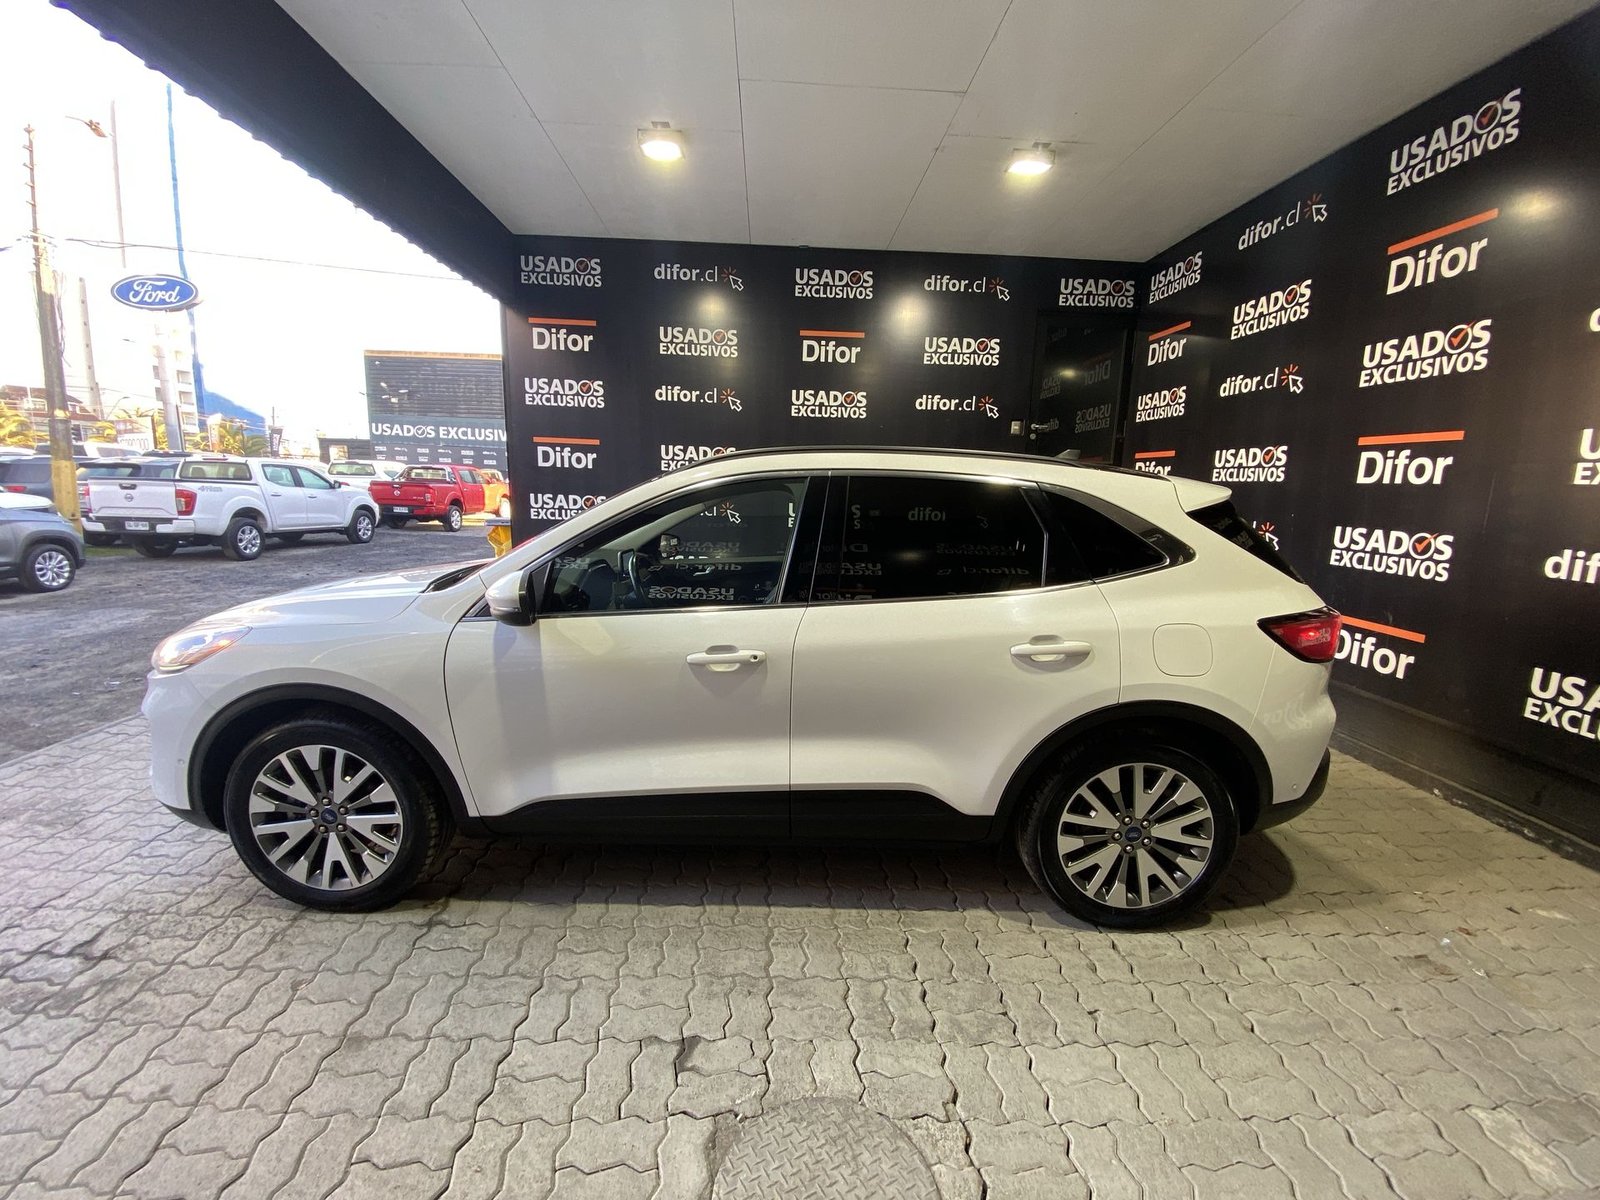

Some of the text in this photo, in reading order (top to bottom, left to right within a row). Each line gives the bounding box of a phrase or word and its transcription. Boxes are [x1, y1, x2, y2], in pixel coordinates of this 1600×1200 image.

[1390, 88, 1521, 174] USADOS
[1387, 118, 1520, 196] EXCLUSIVOS
[1238, 201, 1301, 251] difor.cl
[520, 255, 601, 274] USADOS
[654, 264, 718, 282] difor.cl
[1151, 251, 1202, 291] USADOS
[1386, 238, 1488, 295] Difor
[521, 272, 602, 287] EXCLUSIVOS
[795, 268, 874, 287] USADOS
[924, 275, 986, 293] difor.cl
[1060, 278, 1135, 296] USADOS
[1149, 269, 1201, 304] EXCLUSIVOS
[128, 278, 180, 303] Ford
[795, 285, 873, 299] EXCLUSIVOS
[1059, 294, 1134, 308] EXCLUSIVOS
[1233, 279, 1312, 324] USADOS
[1230, 302, 1310, 340] EXCLUSIVOS
[532, 327, 593, 351] Difor
[659, 326, 738, 346] USADOS
[924, 337, 1000, 355] USADOS
[1362, 319, 1492, 368] USADOS
[659, 343, 738, 358] EXCLUSIVOS
[802, 339, 861, 364] Difor
[923, 353, 1000, 366] EXCLUSIVOS
[1147, 336, 1187, 366] Difor
[1359, 348, 1489, 388] EXCLUSIVOS
[524, 378, 604, 396] USADOS
[1219, 367, 1279, 398] difor.cl
[525, 394, 605, 408] EXCLUSIVOS
[655, 386, 717, 404] difor.cl
[791, 389, 868, 408] USADOS
[915, 395, 976, 412] difor.cl
[1137, 385, 1186, 411] USADOS
[791, 406, 867, 419] EXCLUSIVOS
[1136, 402, 1185, 423] EXCLUSIVOS
[371, 423, 436, 437] USADOS
[537, 446, 597, 469] Difor
[1214, 445, 1288, 468] USADOS
[1356, 449, 1454, 485] Difor
[1212, 463, 1286, 482] EXCLUSIVOS
[1333, 525, 1454, 562] USADOS
[1329, 548, 1450, 582] EXCLUSIVOS
[1334, 629, 1414, 680] Difor
[1523, 697, 1600, 742] EXCL
